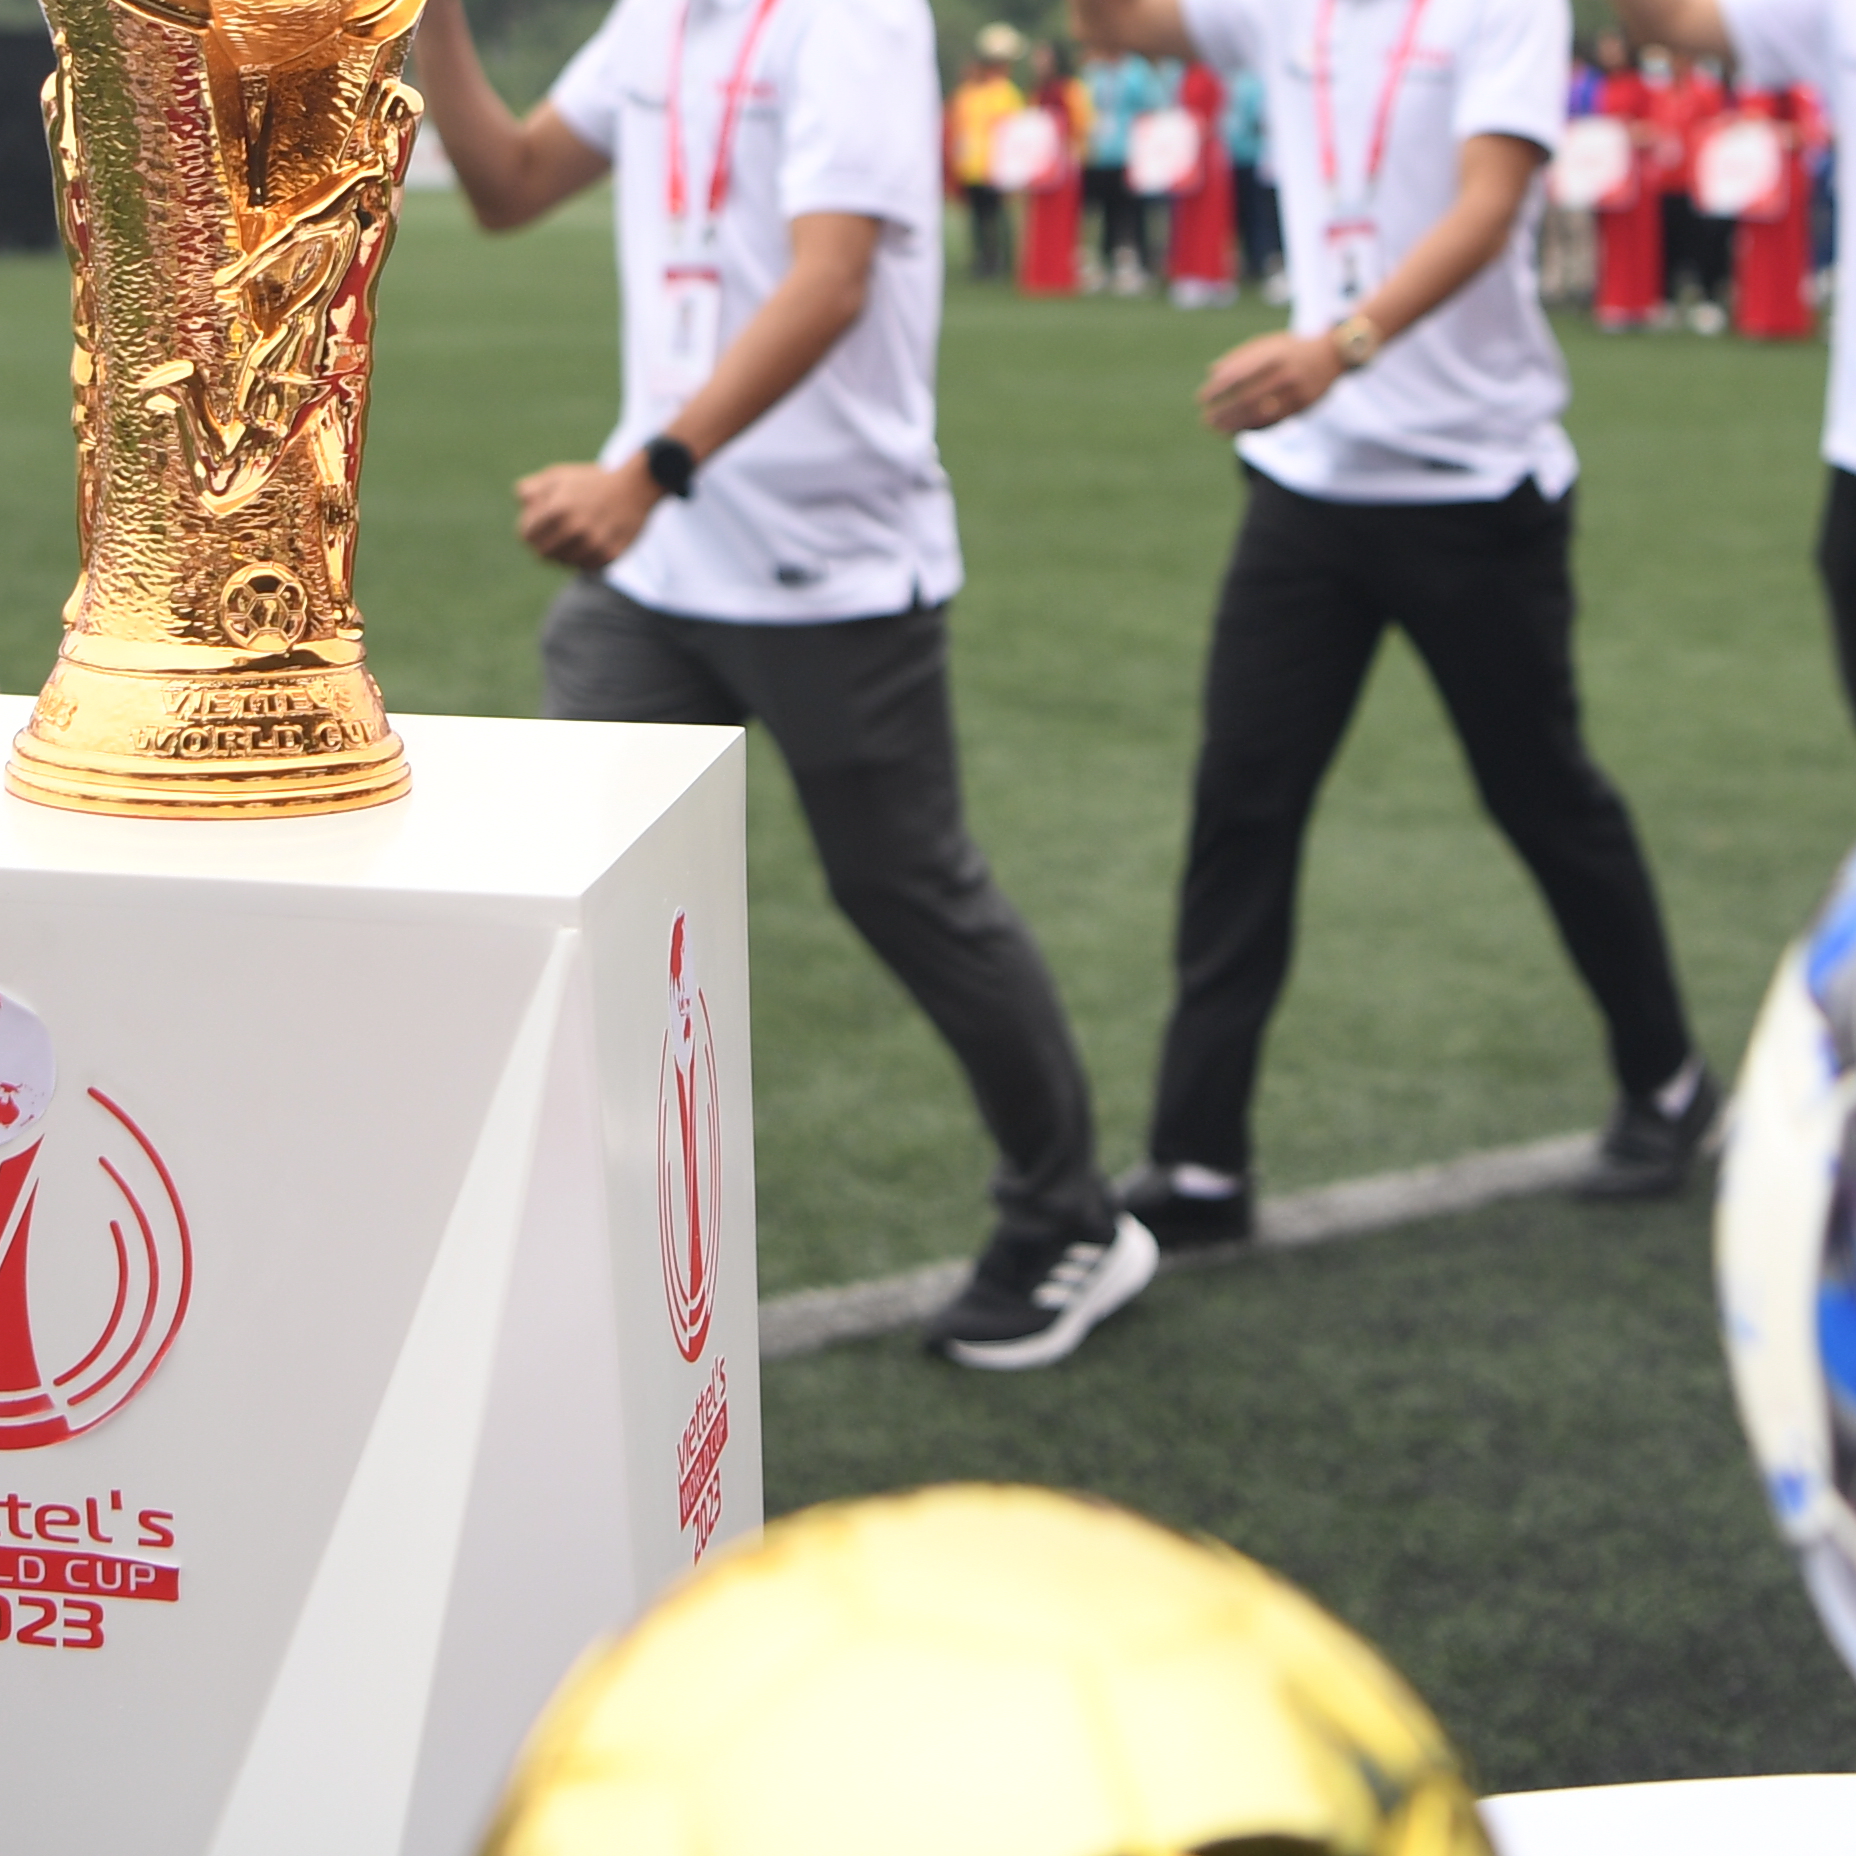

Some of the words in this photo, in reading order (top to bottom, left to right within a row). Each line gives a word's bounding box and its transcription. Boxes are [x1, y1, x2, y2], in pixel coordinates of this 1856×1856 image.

[130, 723, 305, 758] WORLD
[693, 1467, 721, 1567] 2023
[64, 1558, 156, 1592] CUP
